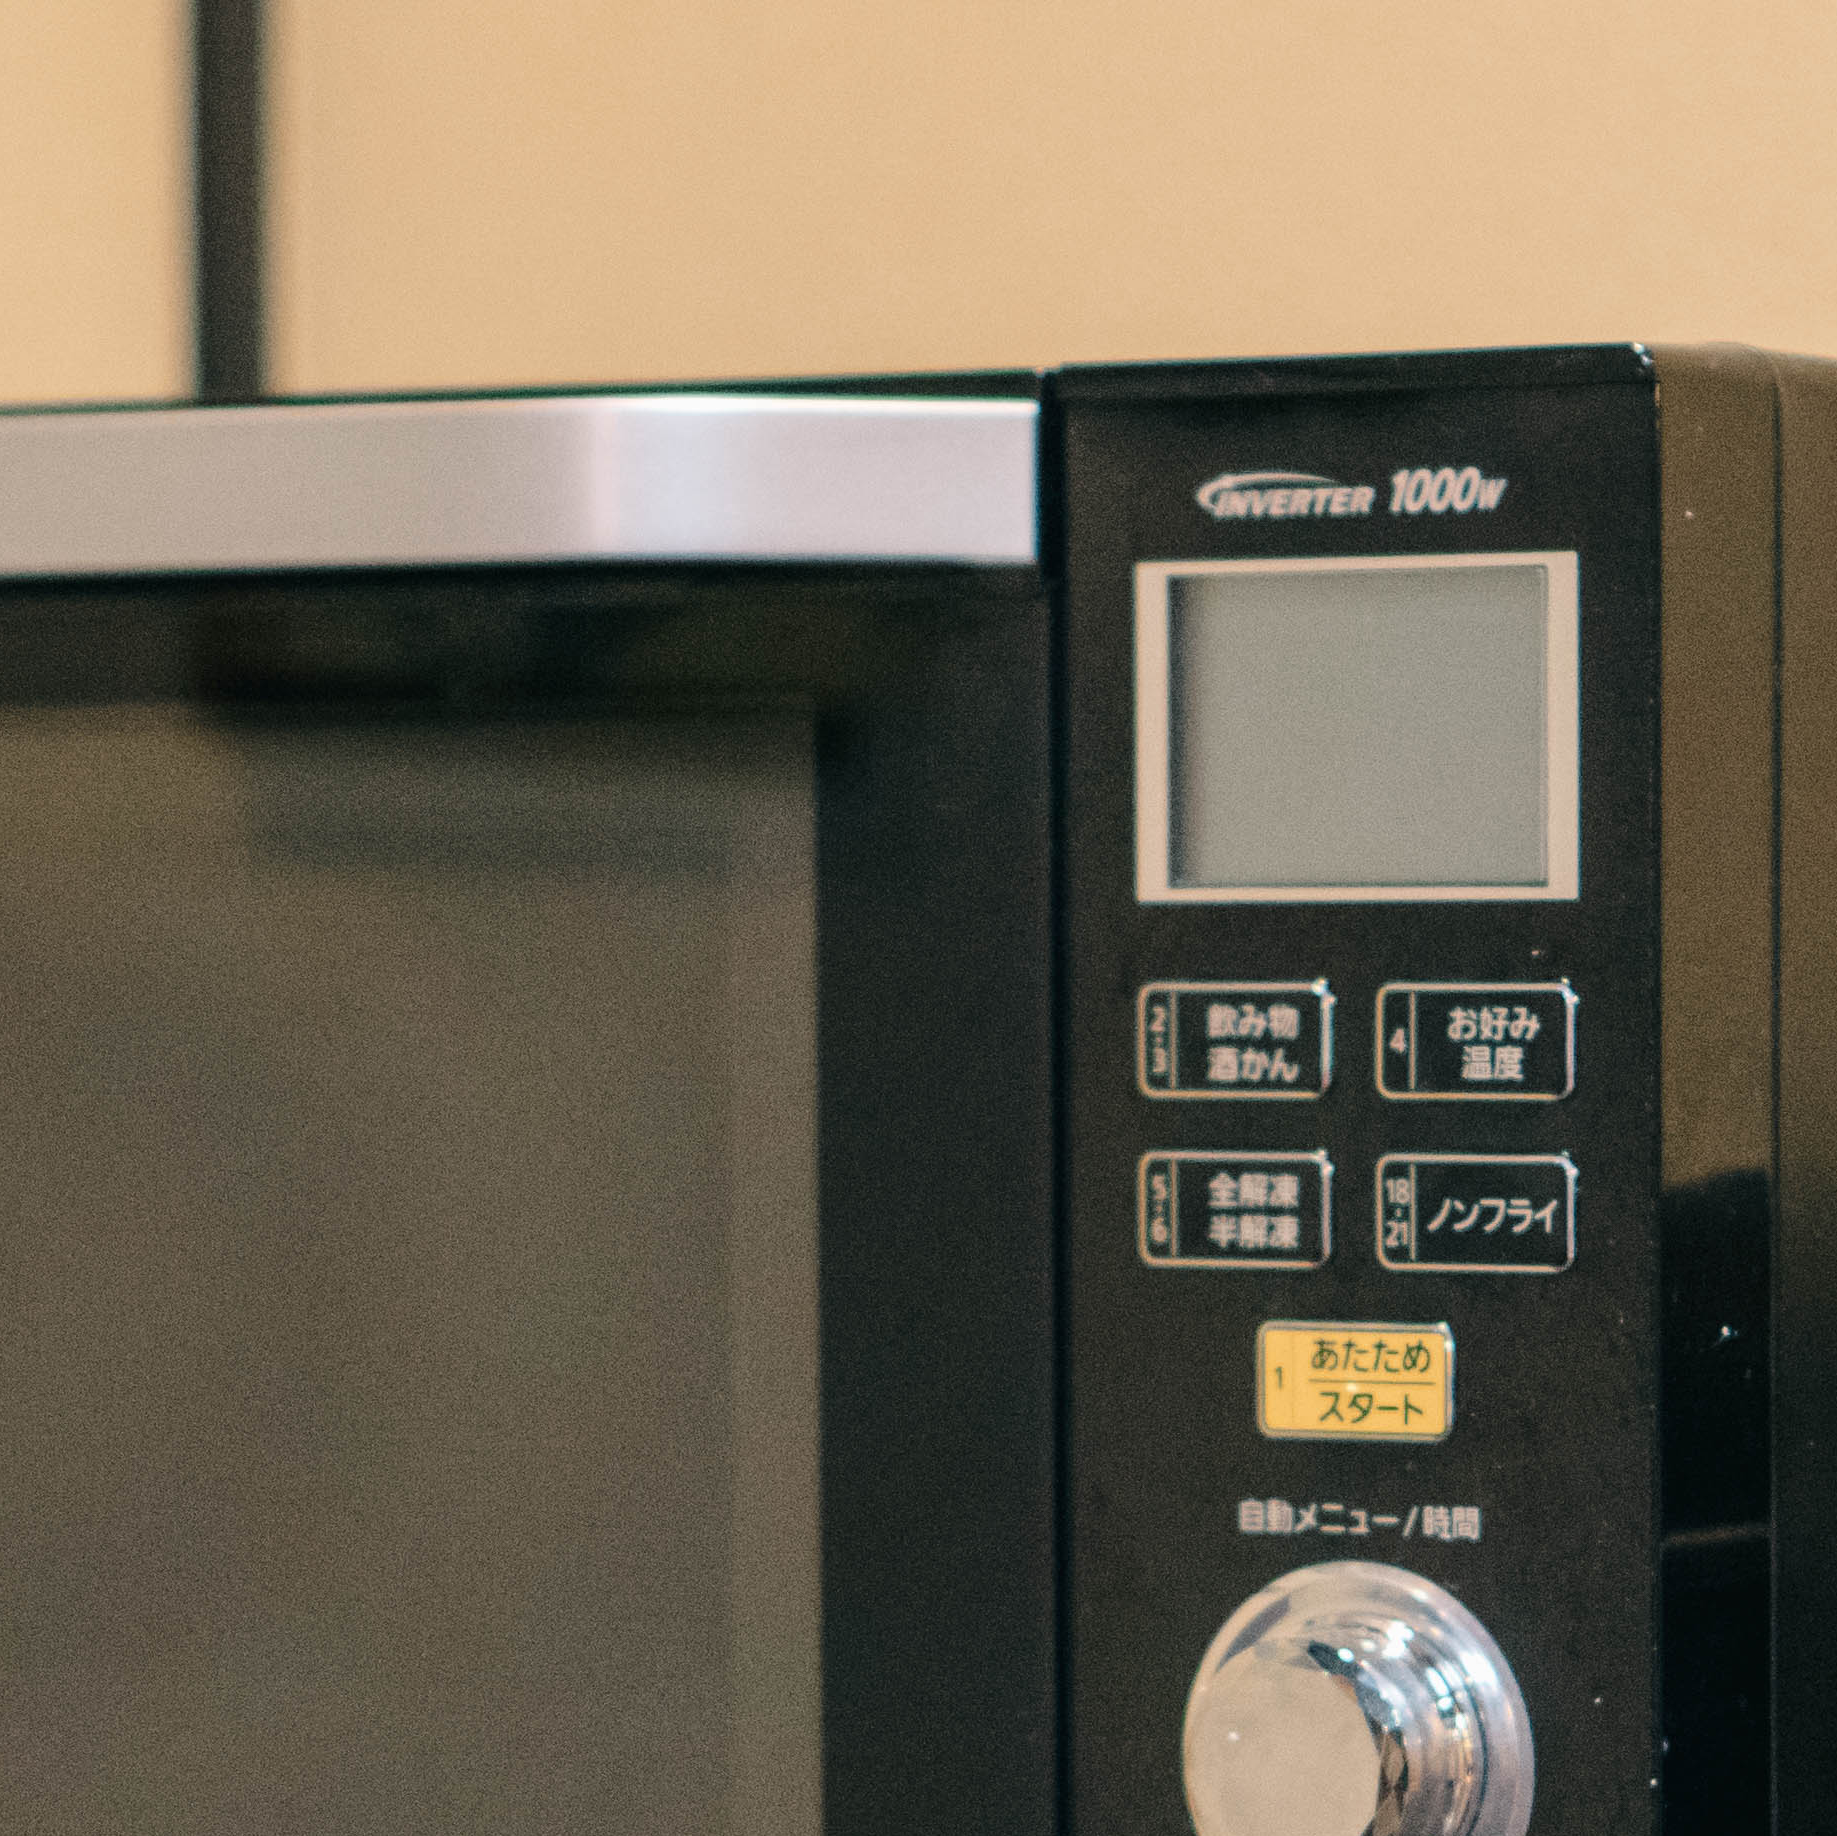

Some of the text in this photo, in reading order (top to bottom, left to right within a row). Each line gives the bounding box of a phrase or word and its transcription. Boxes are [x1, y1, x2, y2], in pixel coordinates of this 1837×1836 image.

[1210, 465, 1507, 519] INVERTER 1000W
[1207, 1003, 1300, 1039] 飲み物
[1447, 1005, 1541, 1041] お好み
[1389, 1028, 1407, 1053] 4
[1207, 1046, 1300, 1083] 酒かん
[1461, 1045, 1524, 1082] 温度
[1208, 1172, 1300, 1208] 全解凍
[1209, 1214, 1300, 1250] 半解凍
[1426, 1198, 1559, 1234] ノンフライ
[1311, 1338, 1431, 1373] あたため
[1273, 1366, 1284, 1389] 1
[1319, 1390, 1423, 1425] スタート
[1237, 1497, 1482, 1542] 自動メニュー/時間
